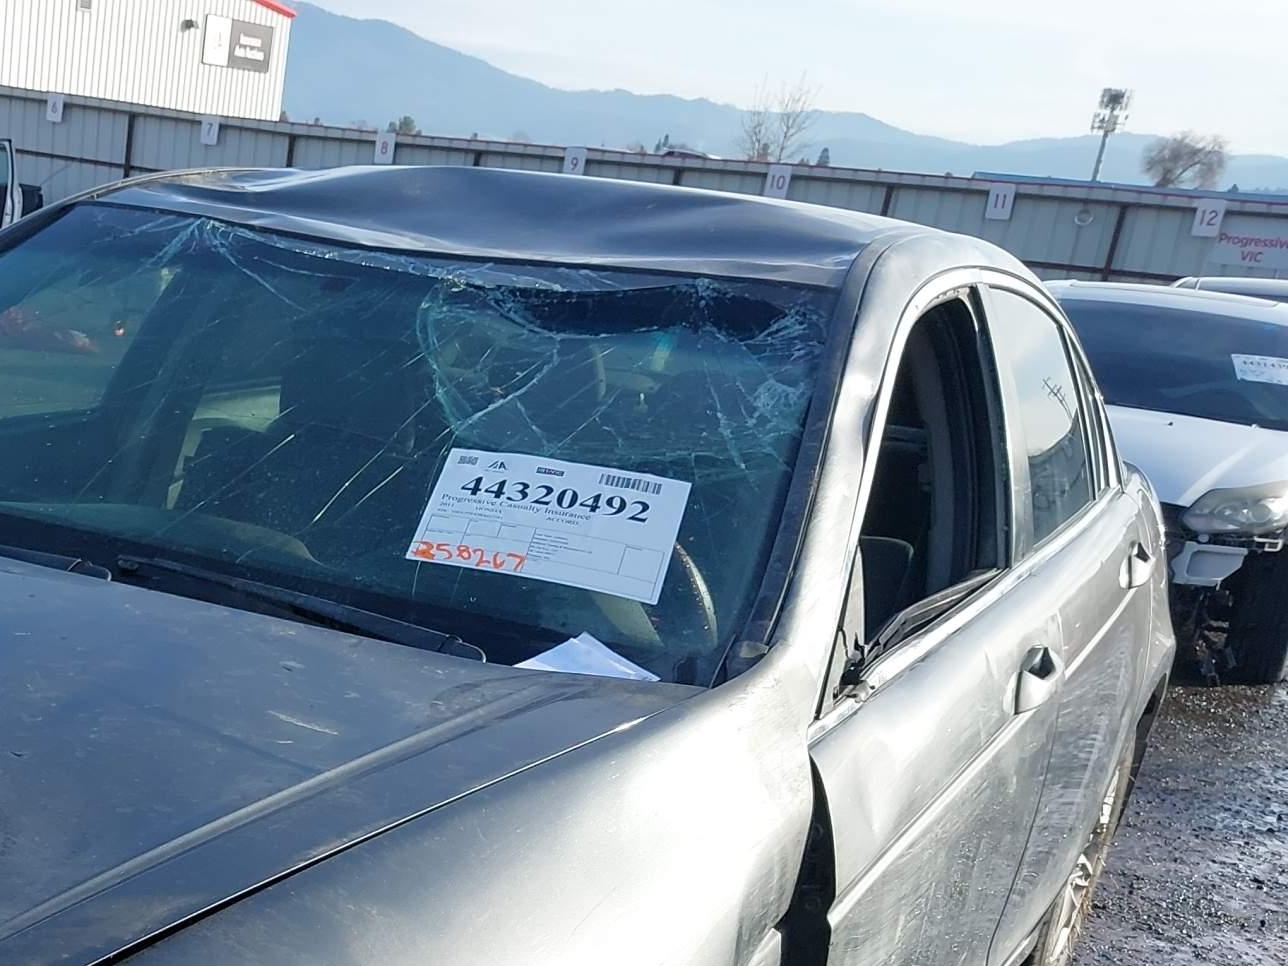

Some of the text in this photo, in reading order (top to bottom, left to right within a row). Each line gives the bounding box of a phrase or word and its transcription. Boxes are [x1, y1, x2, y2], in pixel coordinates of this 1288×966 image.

[50, 101, 58, 115] 6
[206, 122, 214, 137] 7
[380, 141, 388, 155] 8
[570, 157, 578, 171] 9
[769, 174, 786, 190] 10
[994, 193, 1007, 208] 11
[1199, 209, 1218, 226] 12
[1219, 233, 1288, 248] Progressiv
[1241, 251, 1264, 262] VIC
[460, 475, 650, 523] 44320492
[441, 493, 497, 507] Progressive
[499, 500, 541, 514] Casualty
[544, 508, 592, 521] Insurance
